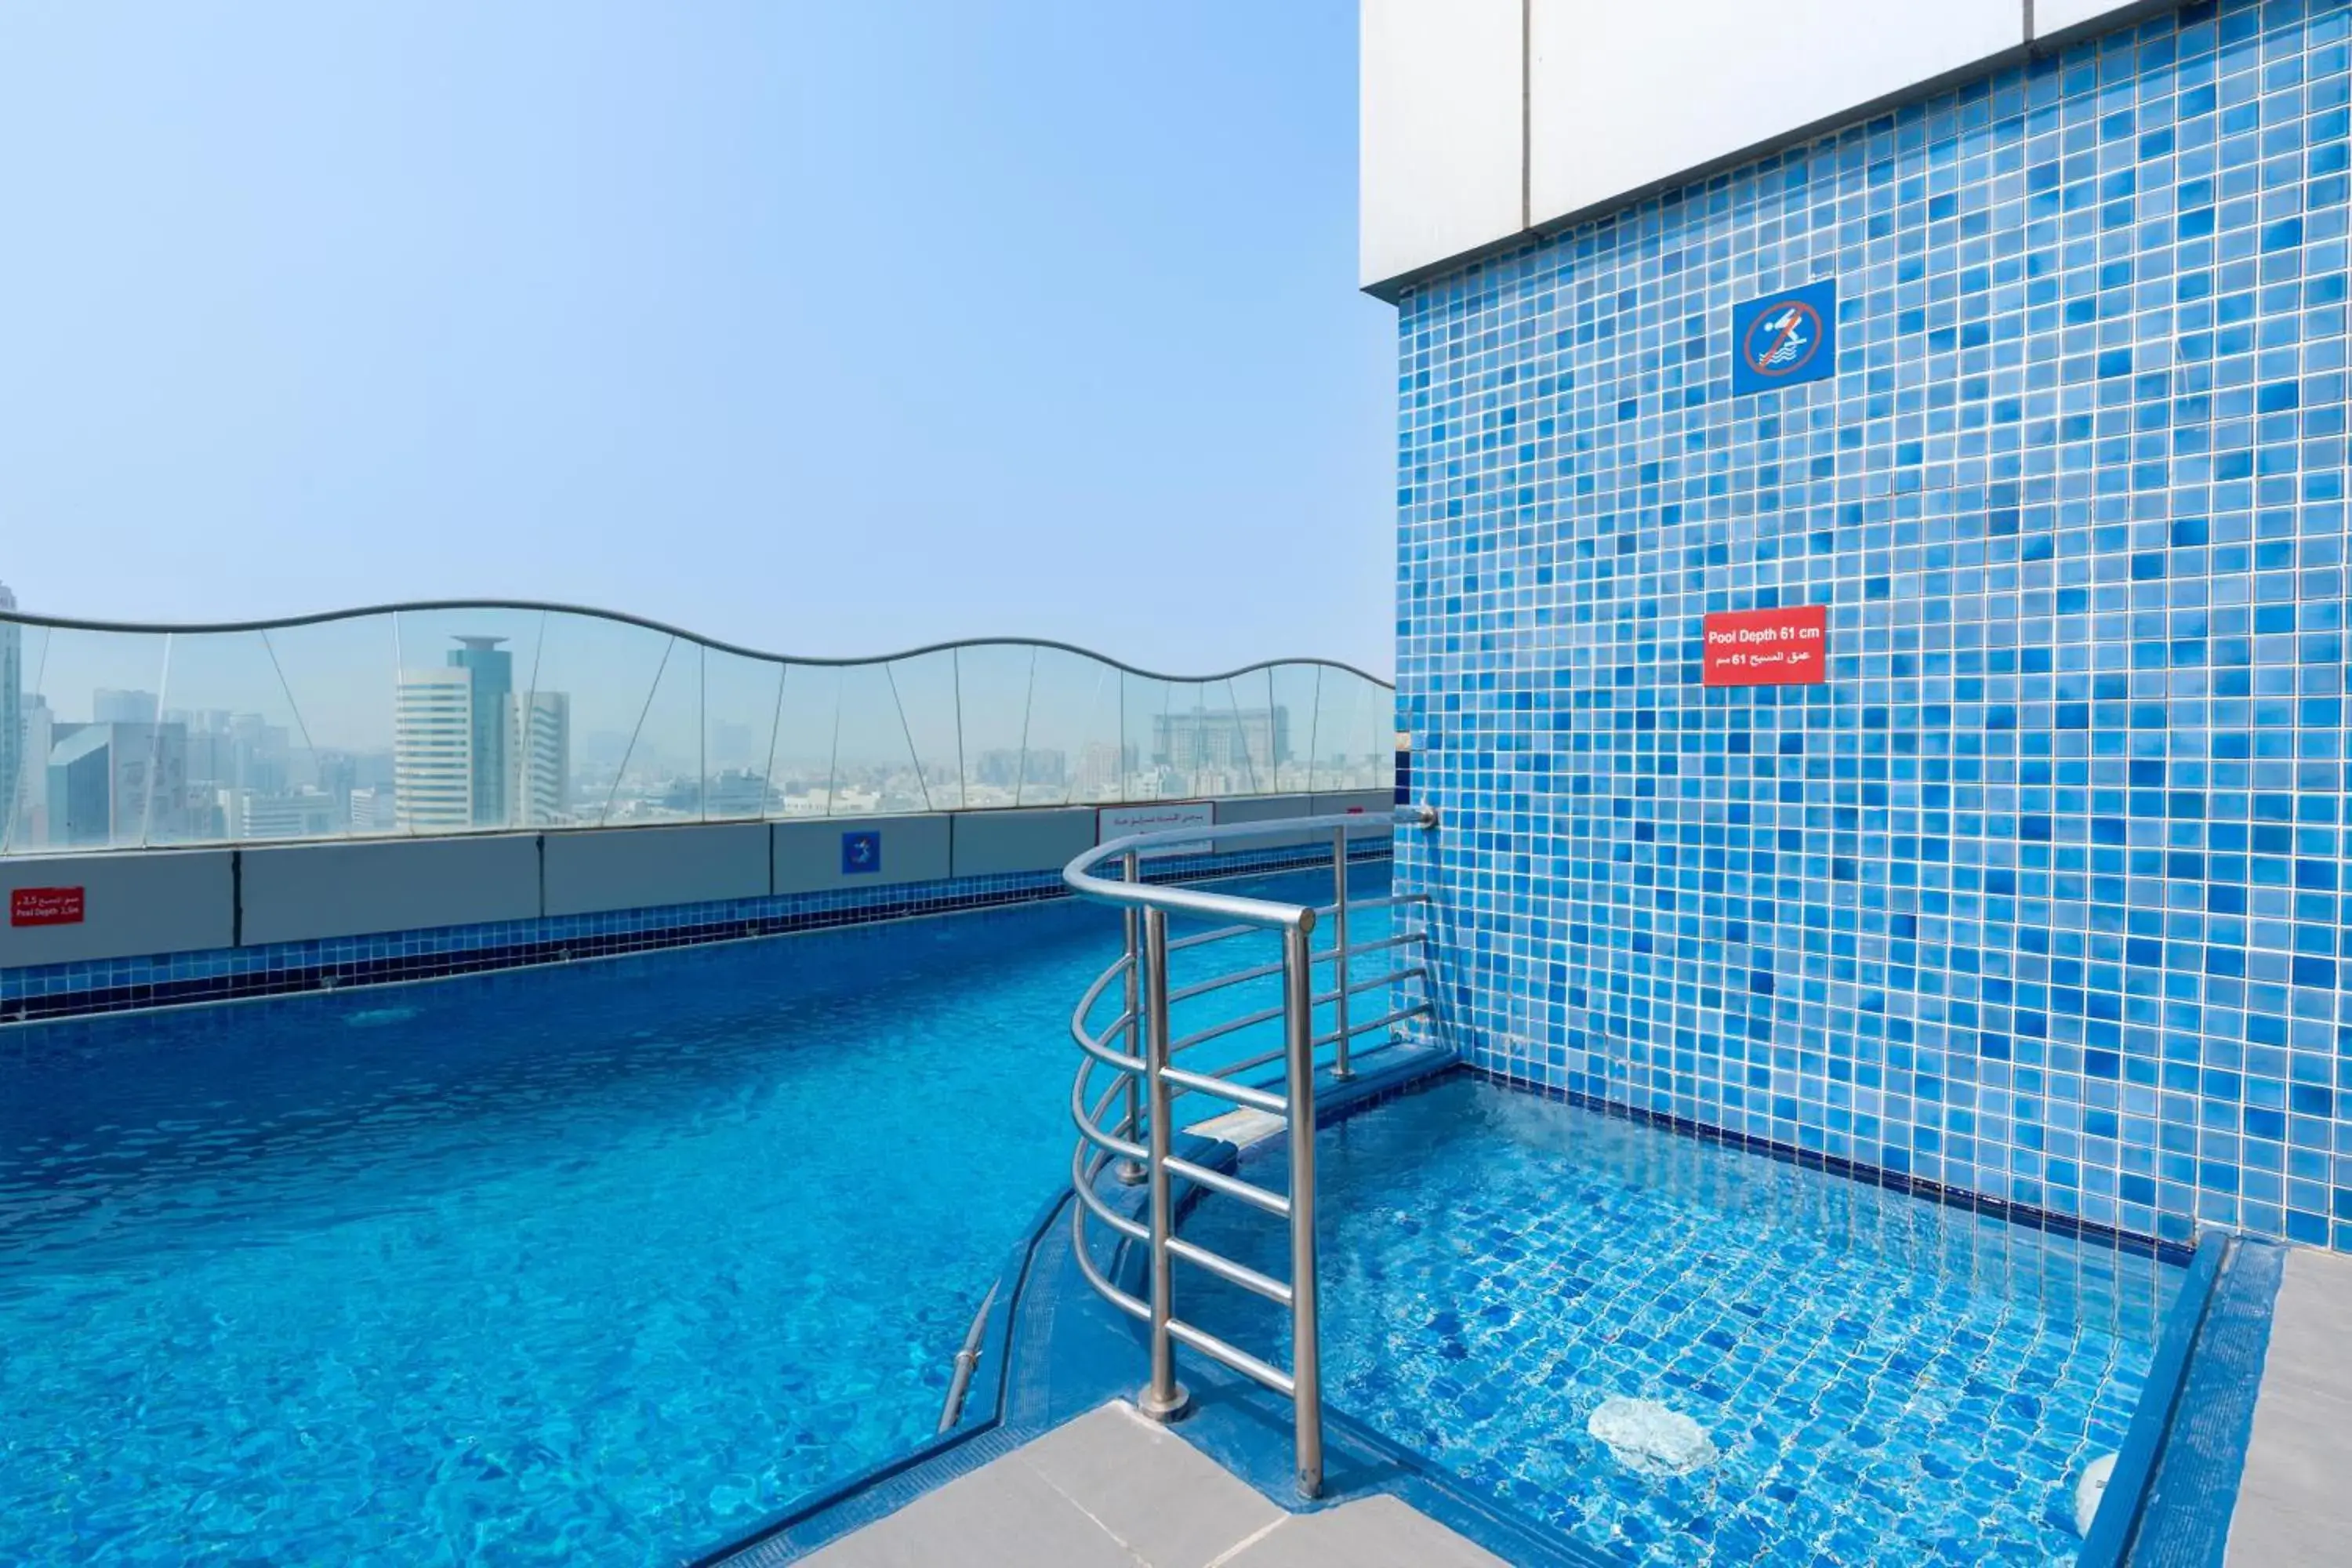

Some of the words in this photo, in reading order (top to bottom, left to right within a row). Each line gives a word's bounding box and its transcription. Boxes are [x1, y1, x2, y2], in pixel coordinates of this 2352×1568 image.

[1708, 630, 1736, 644] Pool
[1739, 629, 1777, 644] Depth
[1780, 626, 1795, 640] 61
[1798, 627, 1820, 639] cm
[1731, 654, 1746, 666] 61
[1749, 652, 1784, 666] المسبح
[1787, 651, 1811, 664] عمق
[16, 908, 34, 916] Pool
[34, 907, 58, 916] Depth
